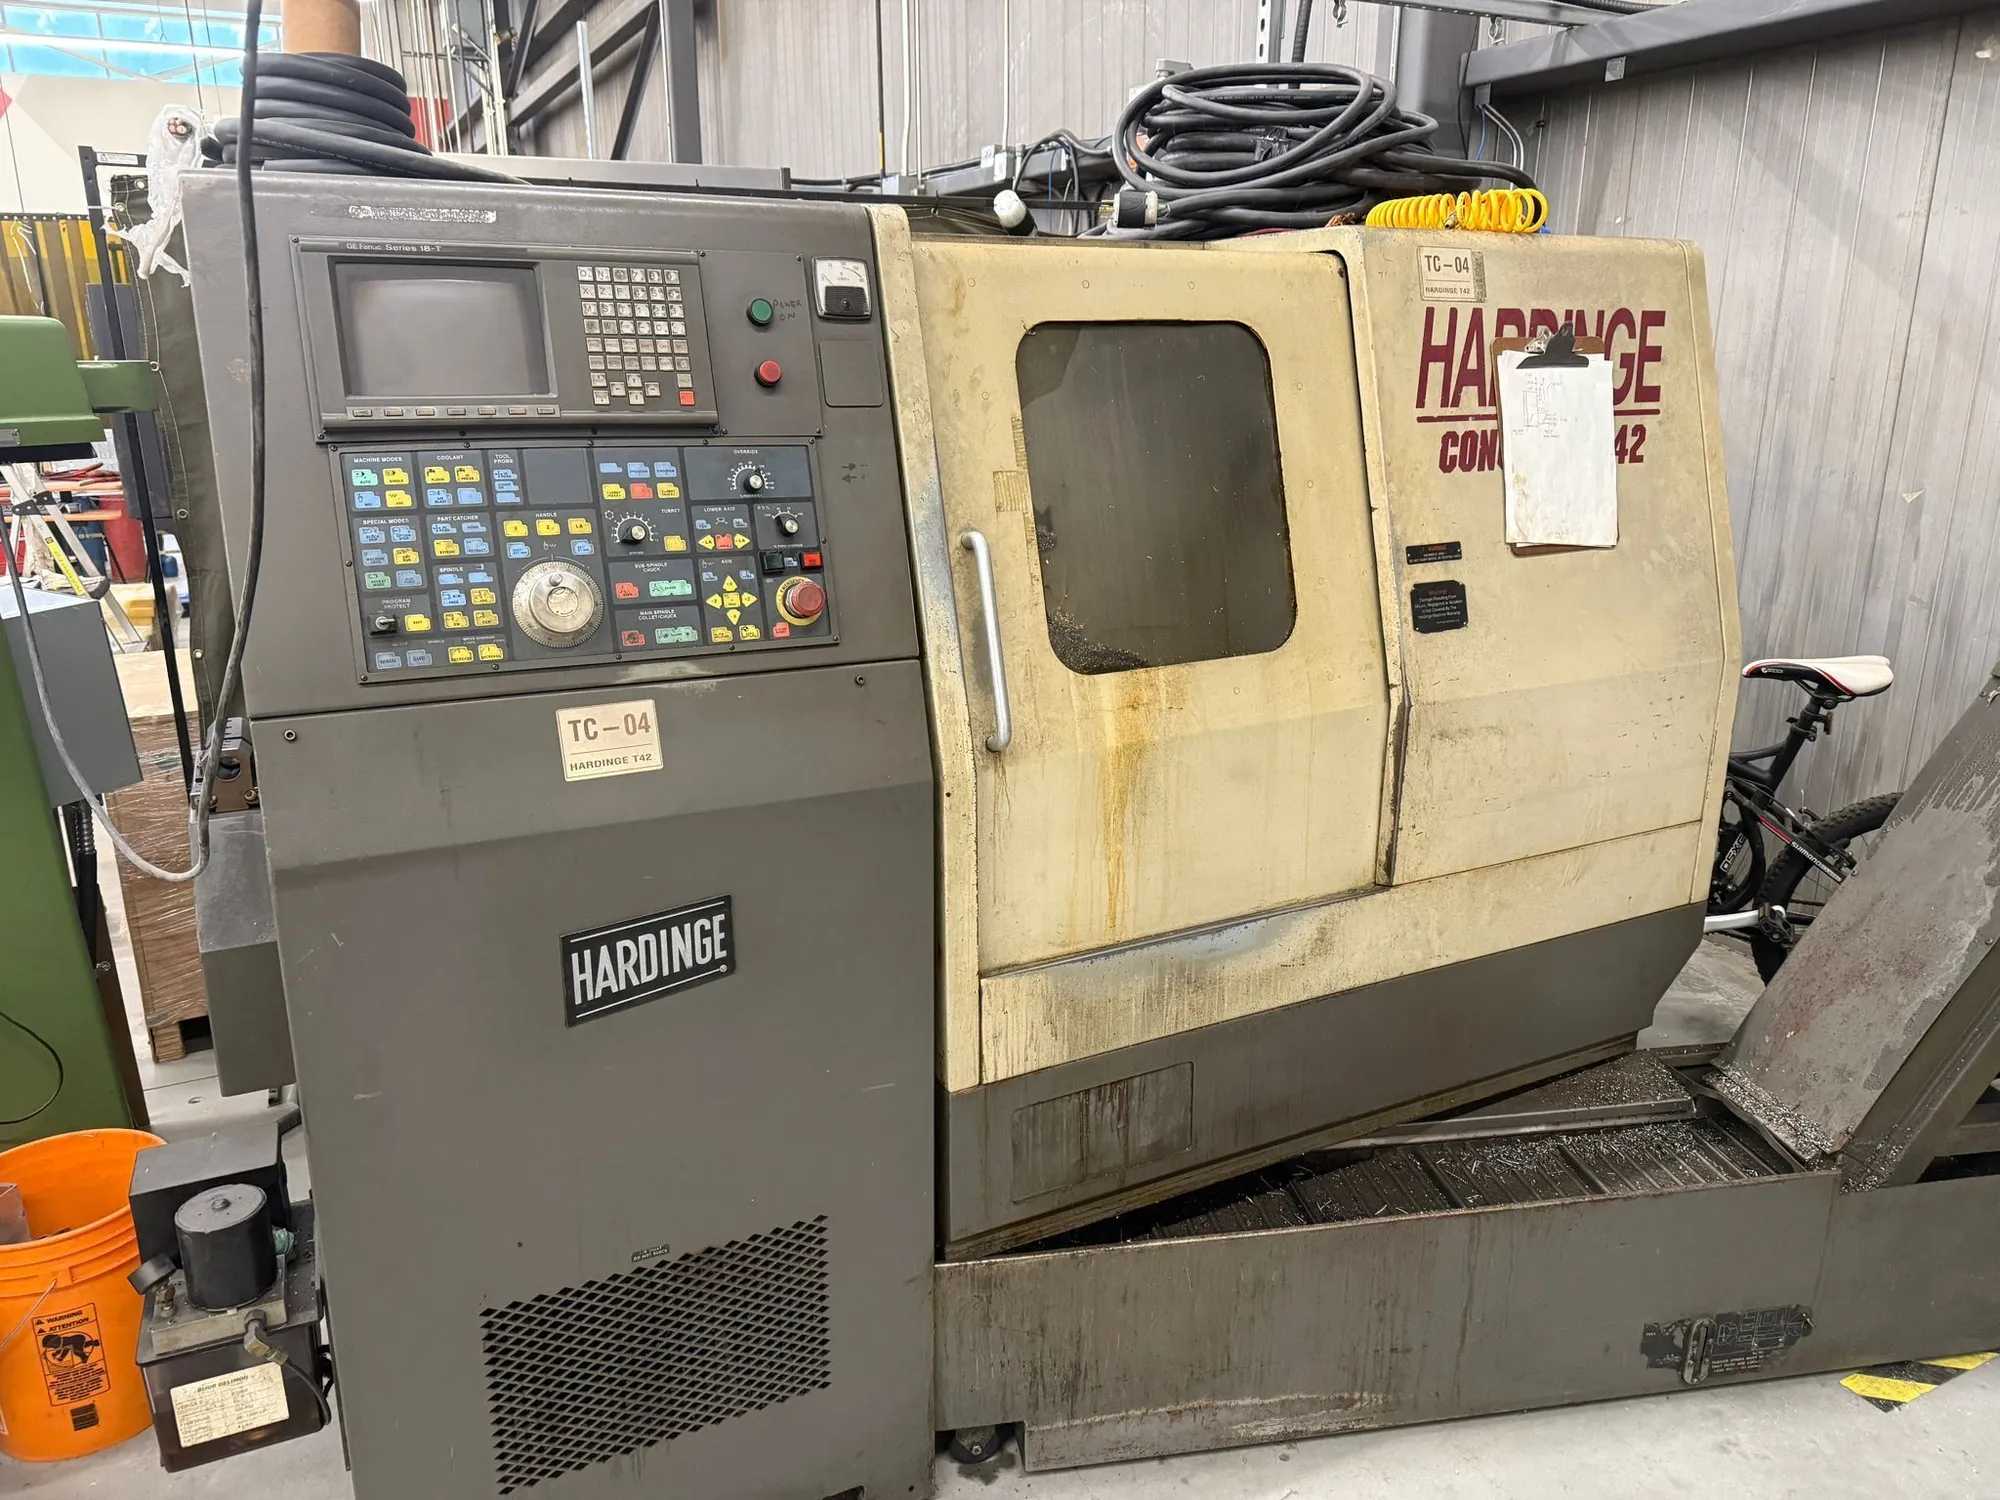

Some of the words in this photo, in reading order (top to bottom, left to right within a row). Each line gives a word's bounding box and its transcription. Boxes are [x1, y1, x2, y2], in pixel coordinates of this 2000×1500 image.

[1425, 286, 1459, 295] HARDINGE
[1460, 287, 1470, 295] T42
[569, 755, 629, 772] HARDINGE
[632, 753, 652, 763] T42
[571, 913, 727, 1005] HARDINGE
[47, 1309, 83, 1323] WARNING
[48, 1317, 89, 1333] ATTENTION
